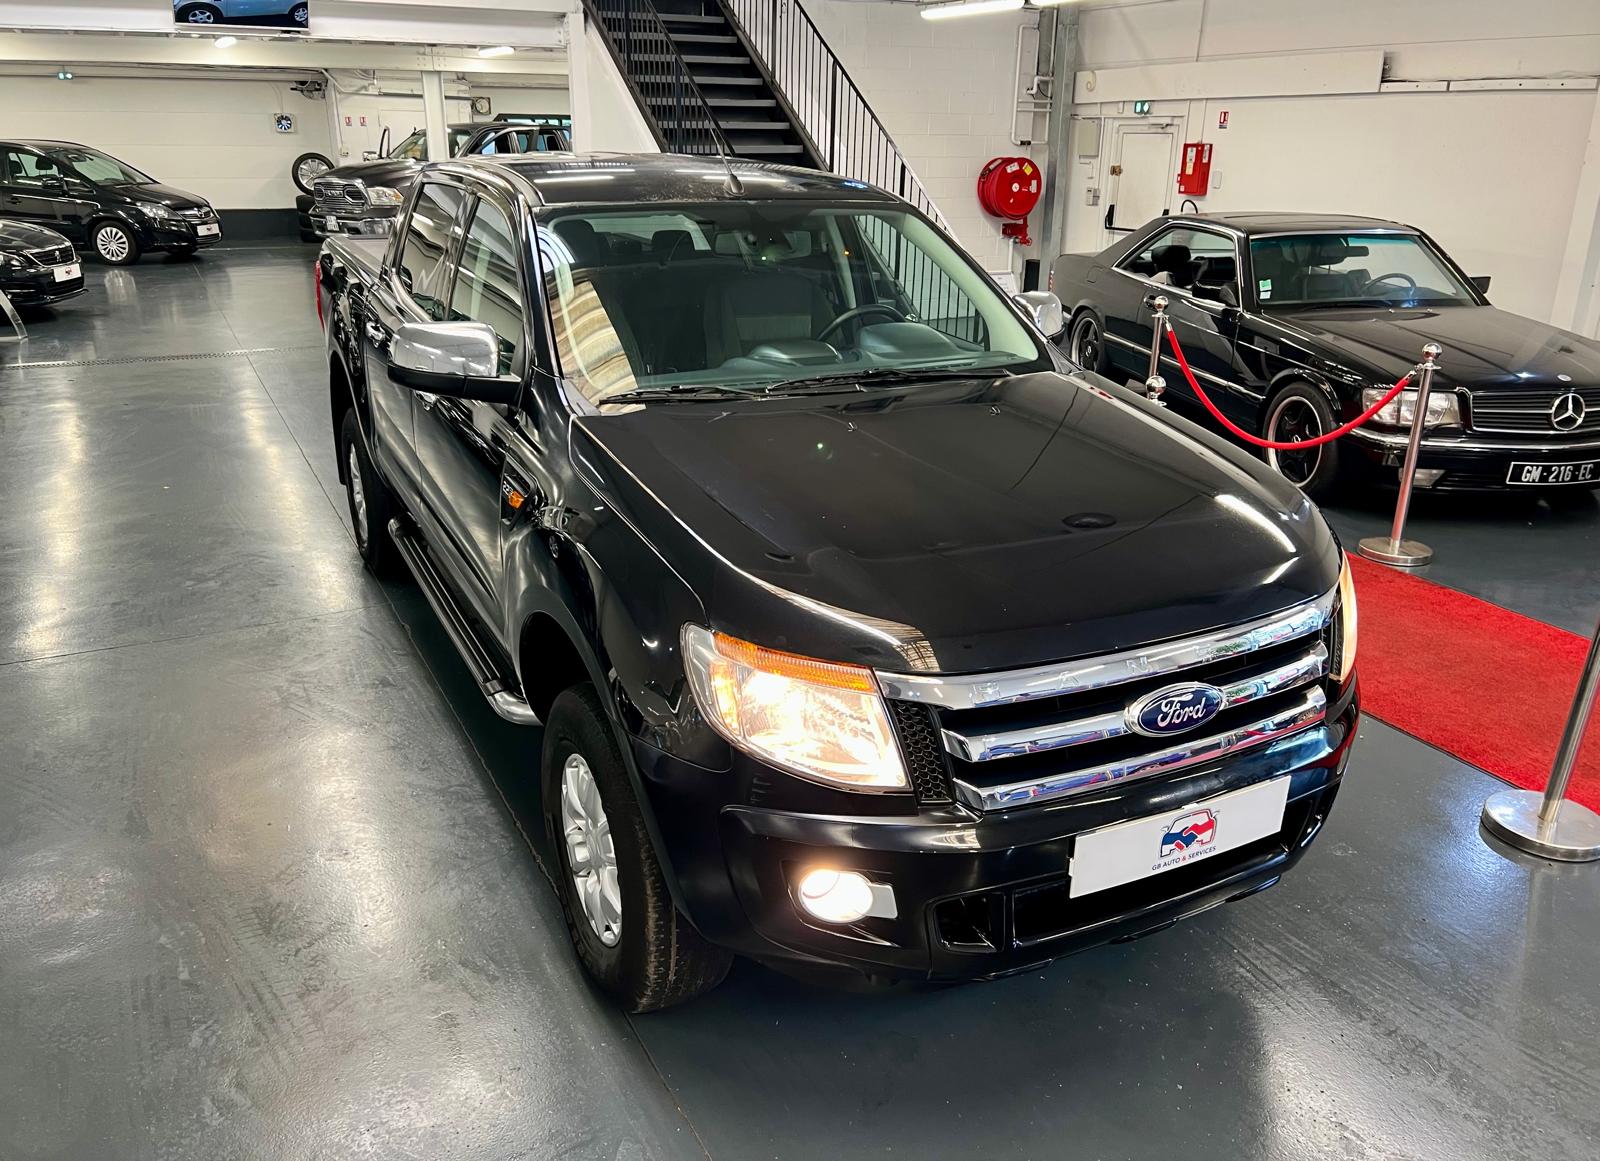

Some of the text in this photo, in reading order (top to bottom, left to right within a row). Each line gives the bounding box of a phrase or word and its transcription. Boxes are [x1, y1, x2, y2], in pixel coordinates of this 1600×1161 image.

[1157, 693, 1207, 728] Ford
[1152, 863, 1162, 871] GB
[1162, 857, 1181, 868] AUTO
[1188, 846, 1216, 859] SERVICES
